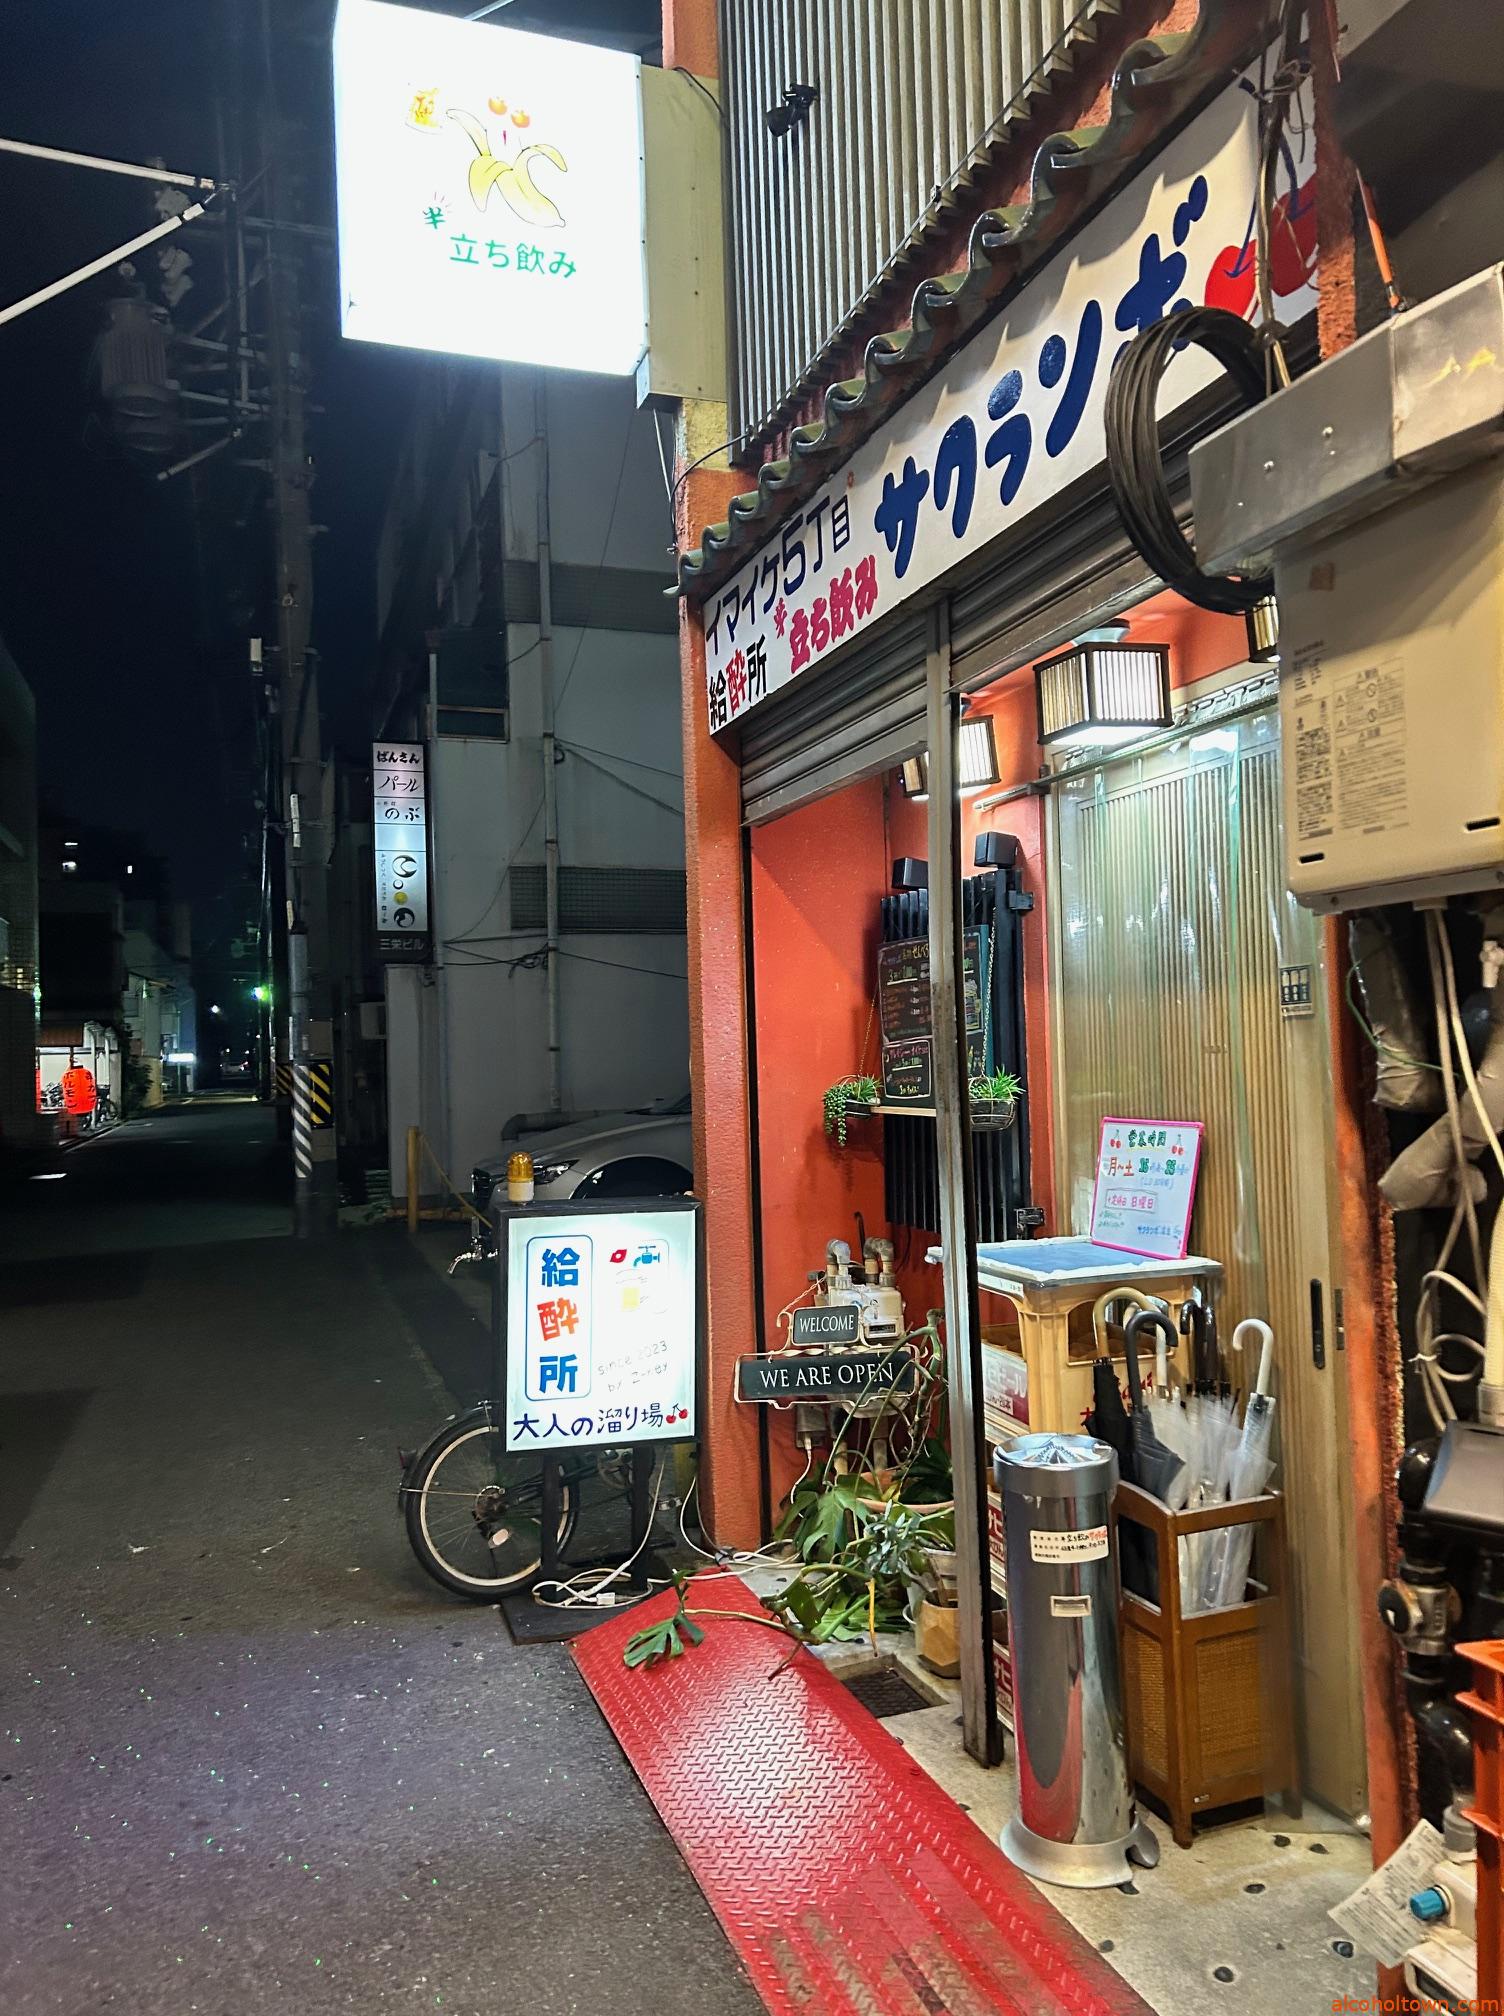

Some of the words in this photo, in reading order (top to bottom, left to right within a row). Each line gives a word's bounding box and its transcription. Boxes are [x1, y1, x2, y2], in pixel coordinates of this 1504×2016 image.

[874, 175, 1208, 578] サクランボ
[709, 634, 768, 728] 給酔所
[377, 776, 419, 792] パール
[385, 807, 420, 822] のぶ
[536, 1247, 581, 1394] 給酔所
[800, 1314, 855, 1333] WELCOME
[760, 1371, 790, 1389] WE
[796, 1366, 832, 1386] ARE
[838, 1362, 894, 1384] OPEN
